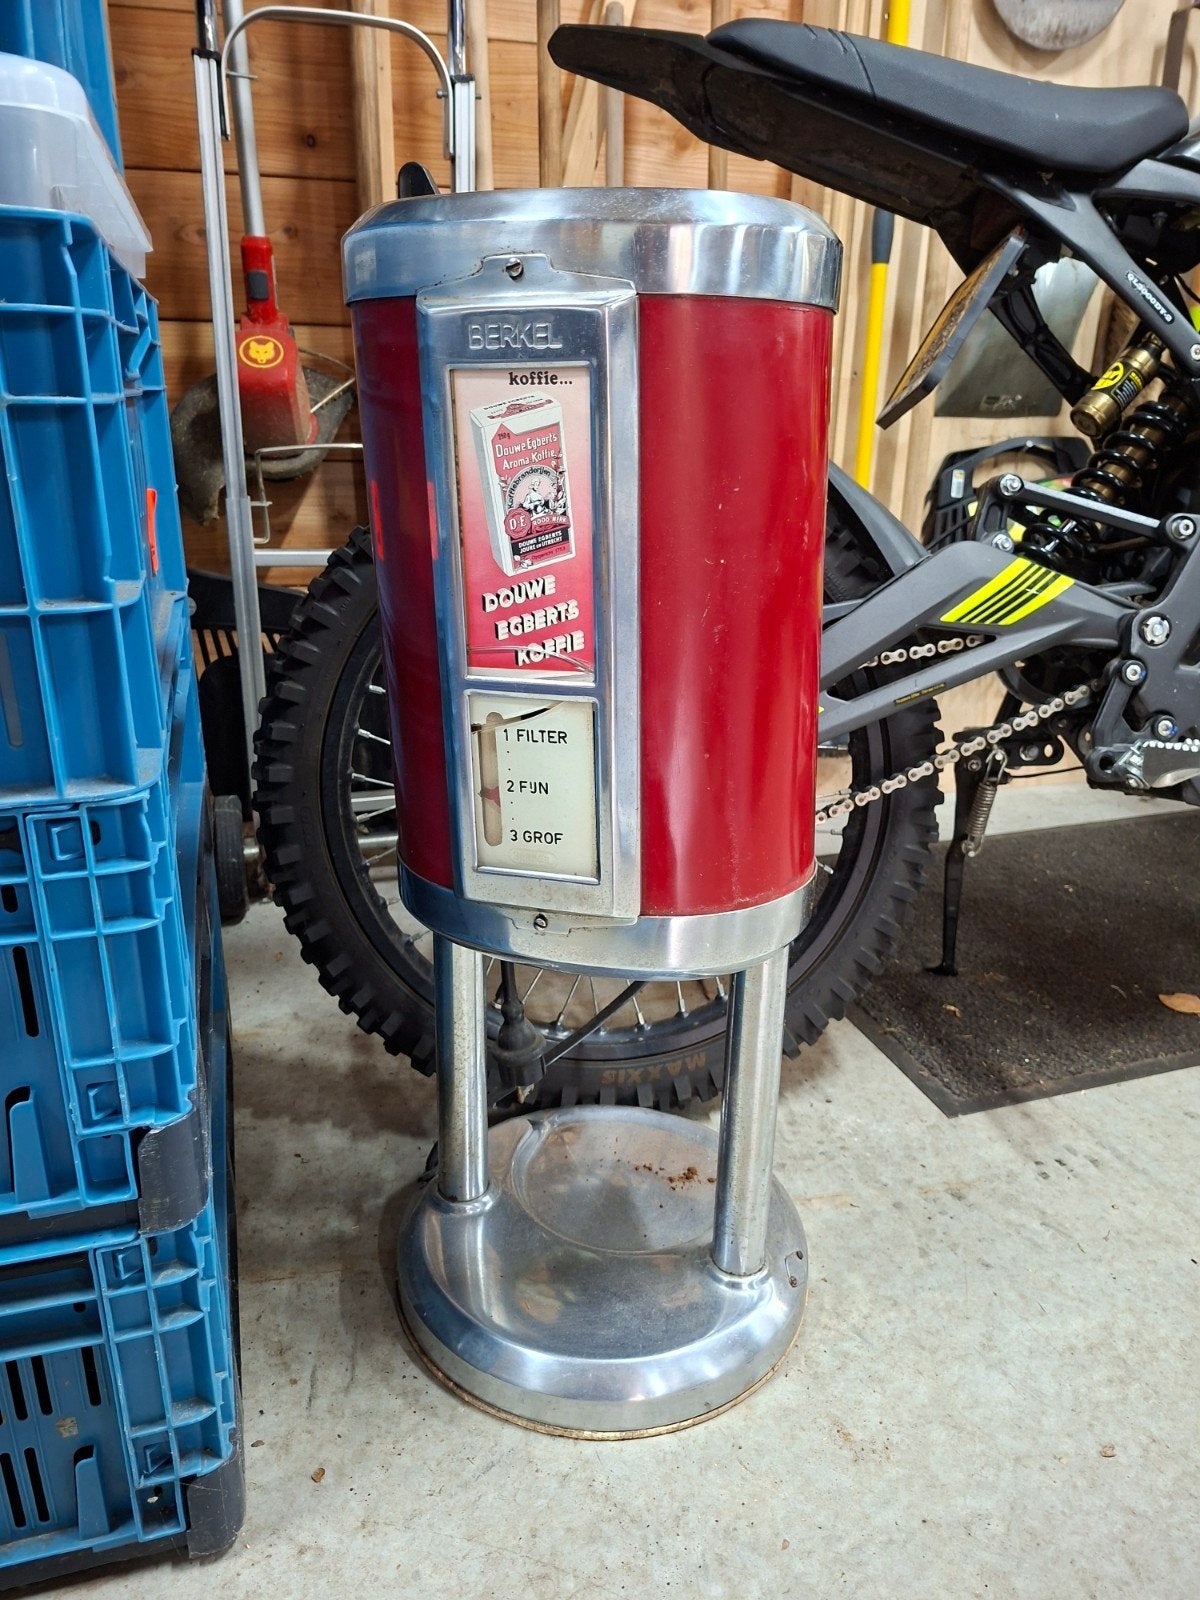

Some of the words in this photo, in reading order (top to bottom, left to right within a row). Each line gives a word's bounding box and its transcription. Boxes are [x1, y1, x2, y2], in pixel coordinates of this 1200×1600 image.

[468, 322, 563, 350] BERKEL
[508, 371, 573, 386] koffie...
[495, 443, 527, 458] Douwe
[526, 432, 558, 451] Egberts
[481, 574, 556, 613] DOUWE
[494, 599, 580, 641] EGBERTS
[515, 629, 585, 667] KOFFIE
[503, 728, 509, 742] 1
[516, 728, 568, 744] FILTER
[506, 780, 515, 793] 2
[519, 780, 549, 795] FIJN
[510, 829, 518, 842] 3
[522, 830, 564, 845] GROF
